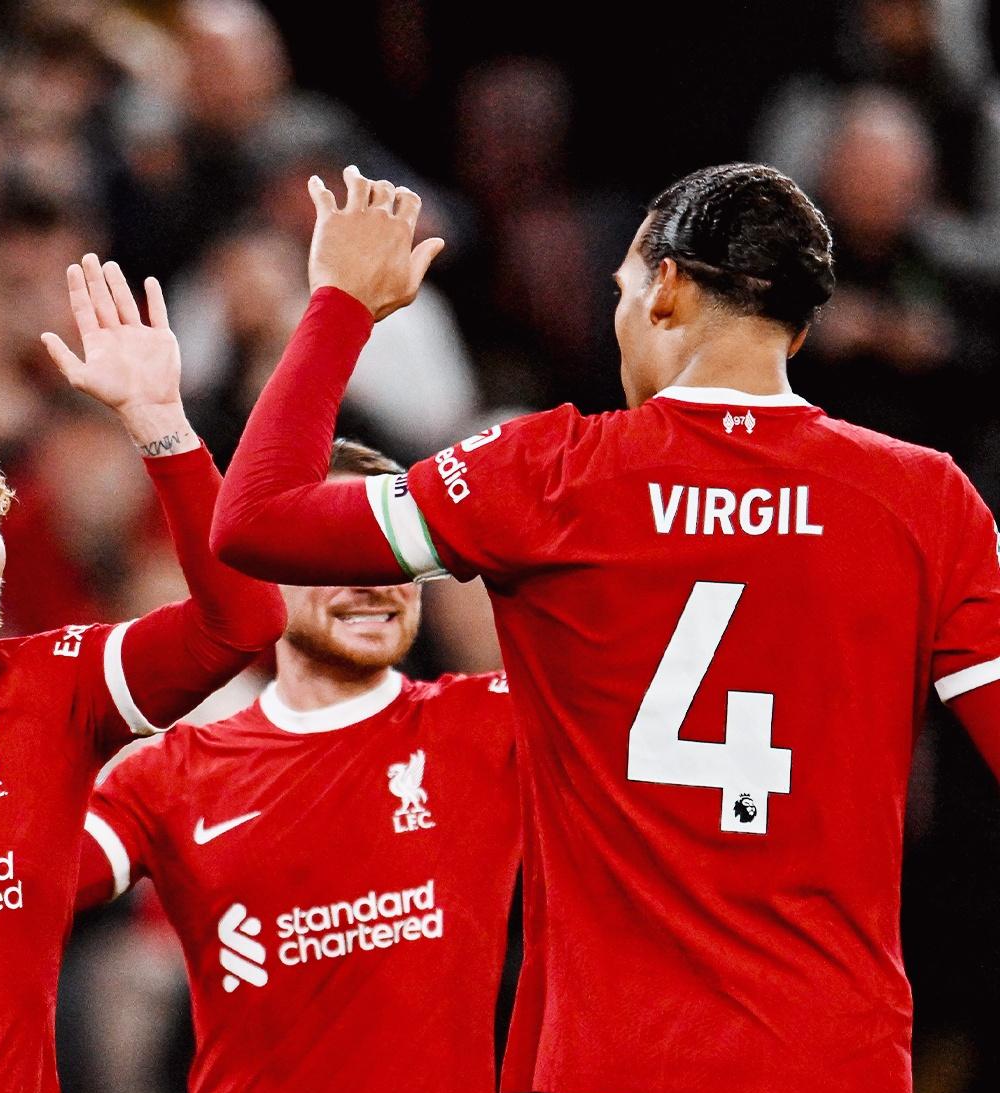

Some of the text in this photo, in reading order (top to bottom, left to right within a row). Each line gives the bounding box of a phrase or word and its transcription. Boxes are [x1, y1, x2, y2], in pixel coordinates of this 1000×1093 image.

[733, 415, 746, 426] 97
[648, 482, 824, 536] VIRGIL
[627, 580, 792, 835] 4
[276, 879, 435, 939] standard
[278, 908, 444, 967] chartered
